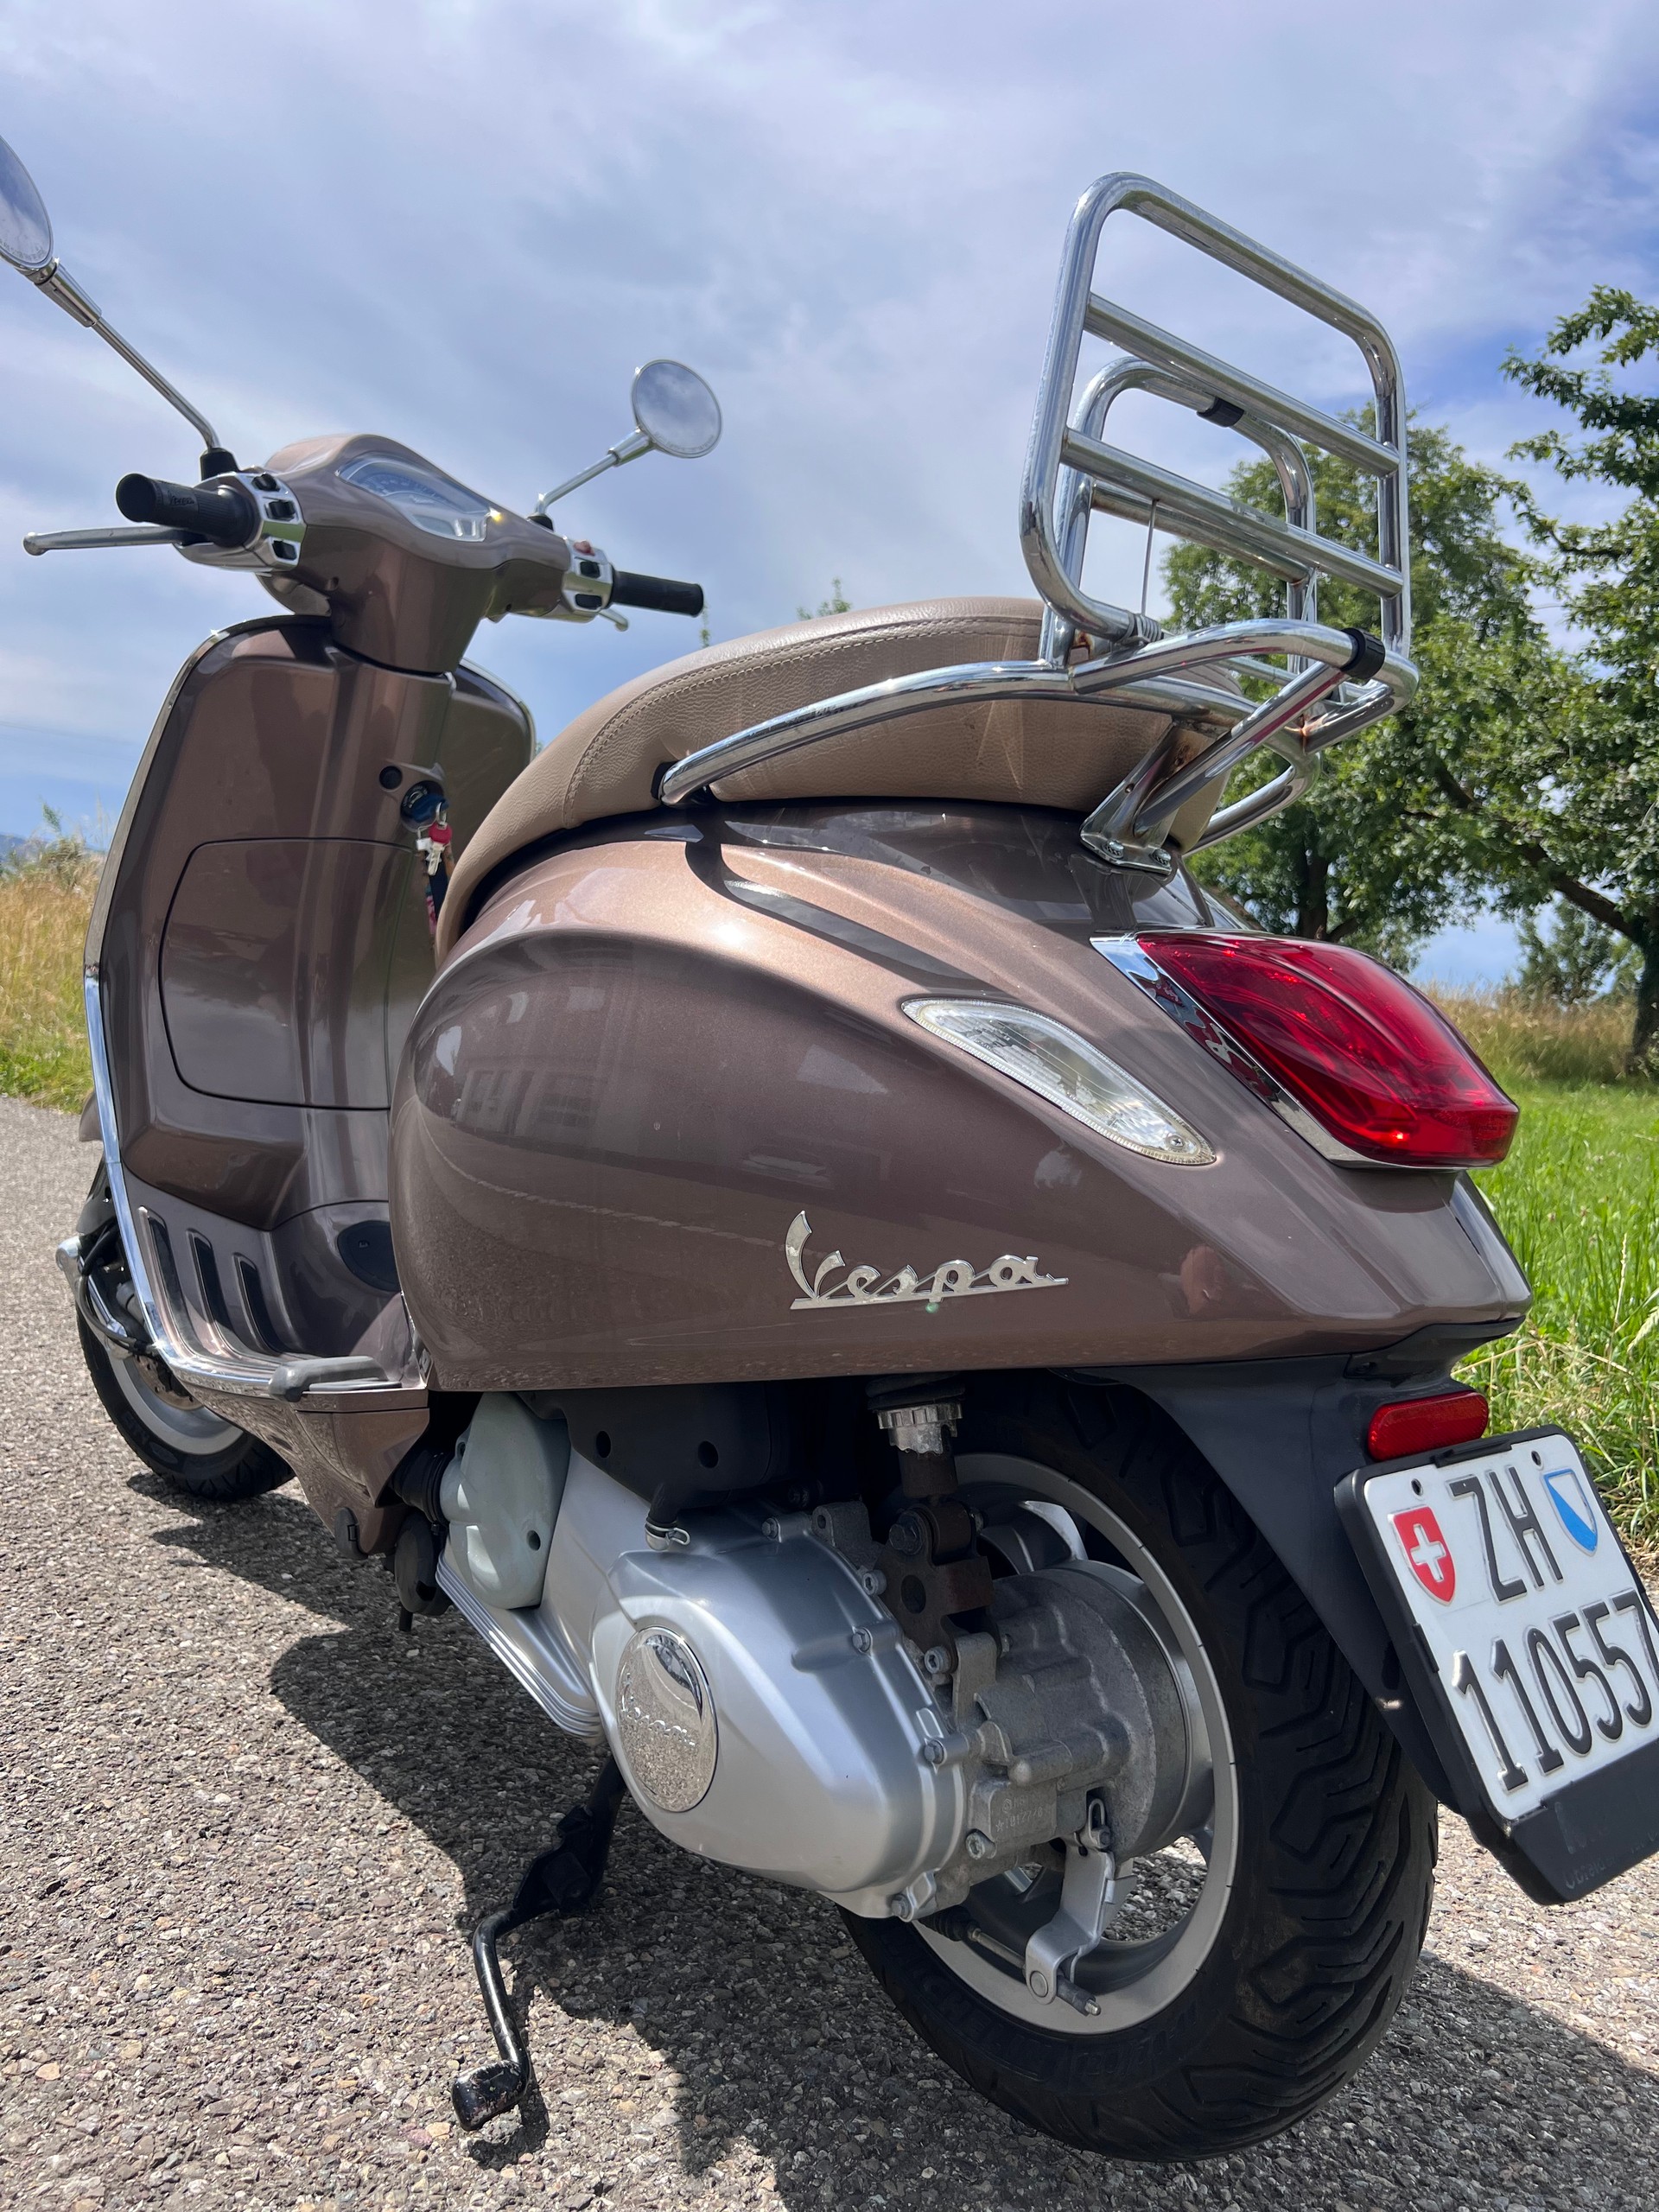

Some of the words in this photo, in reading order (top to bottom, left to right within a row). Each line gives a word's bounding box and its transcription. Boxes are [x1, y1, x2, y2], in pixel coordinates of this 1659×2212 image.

[785, 1210, 1070, 1310] Vespa
[1448, 1465, 1564, 1603] ZH
[1454, 1590, 1659, 1792] 110557
